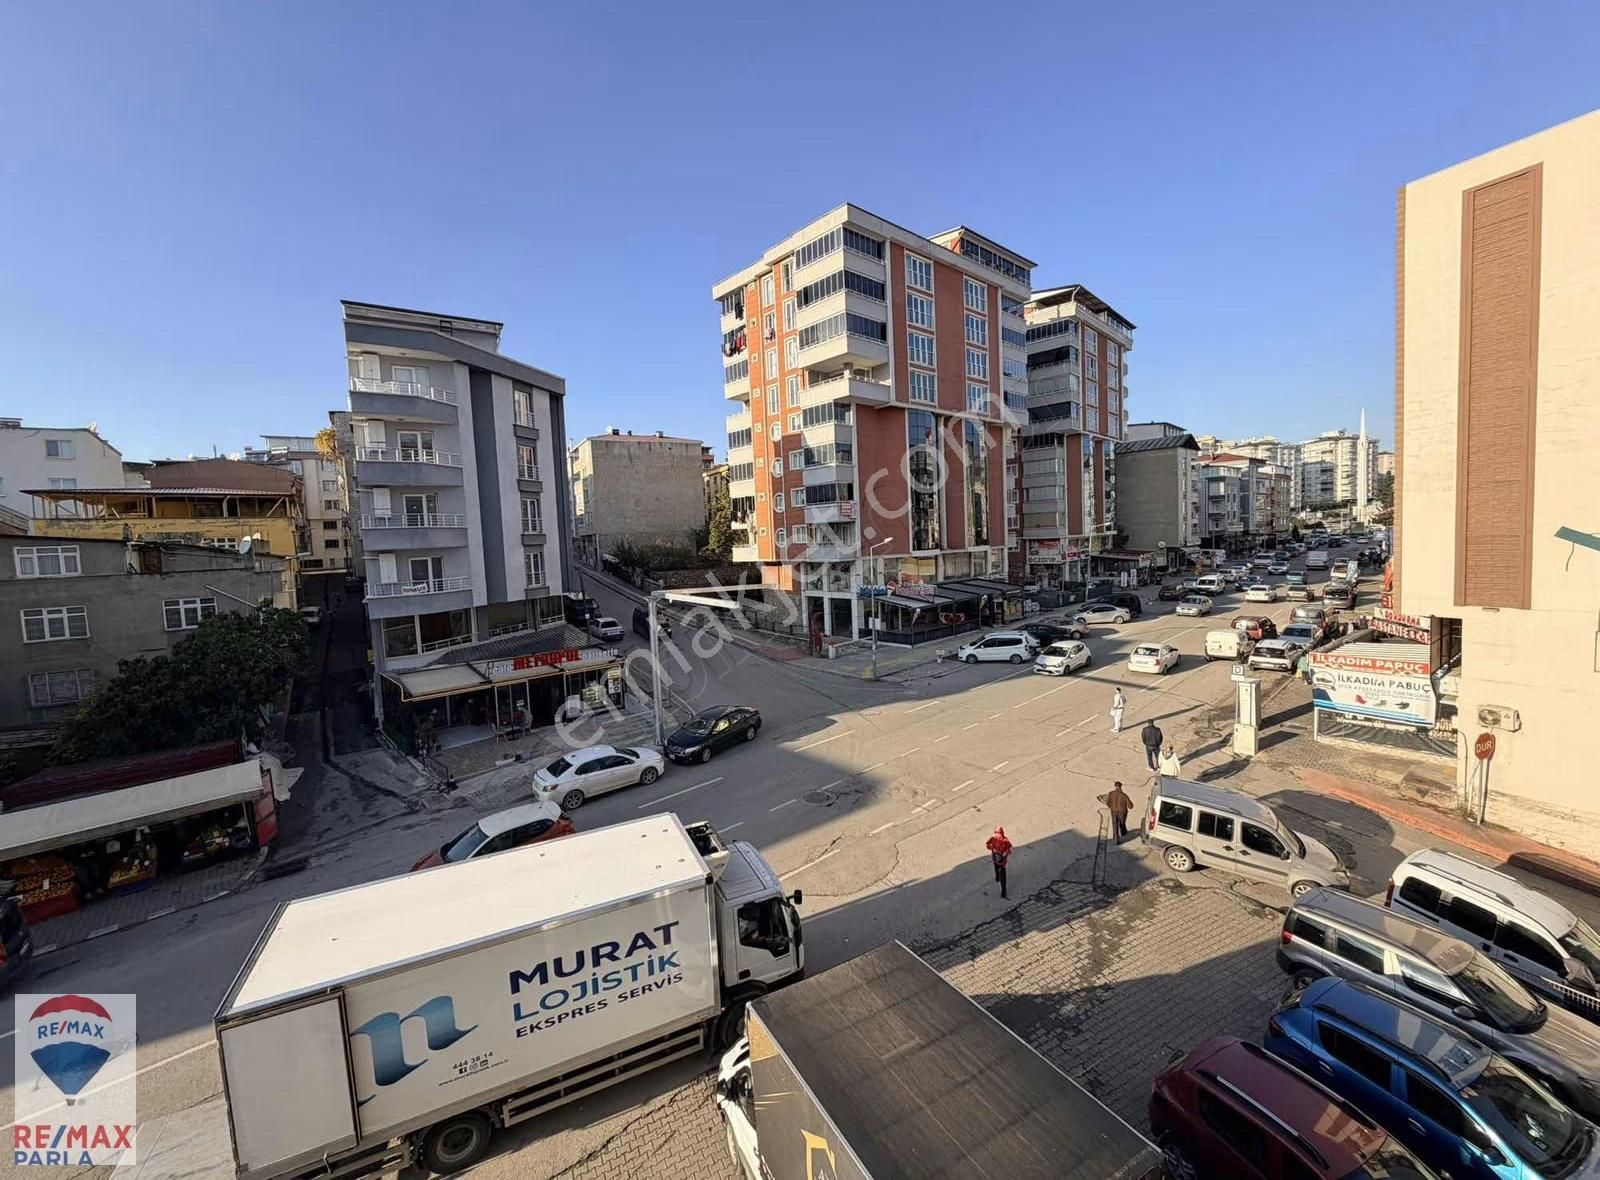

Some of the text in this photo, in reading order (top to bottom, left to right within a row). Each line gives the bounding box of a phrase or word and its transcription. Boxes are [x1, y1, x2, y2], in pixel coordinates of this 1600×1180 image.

[1389, 679, 1431, 694] PABUÇ
[1476, 739, 1492, 753] DUR
[509, 920, 679, 995] MURAT
[512, 950, 681, 1023] LOJİSTİK
[516, 972, 683, 1038] EKSPRES SERVİS
